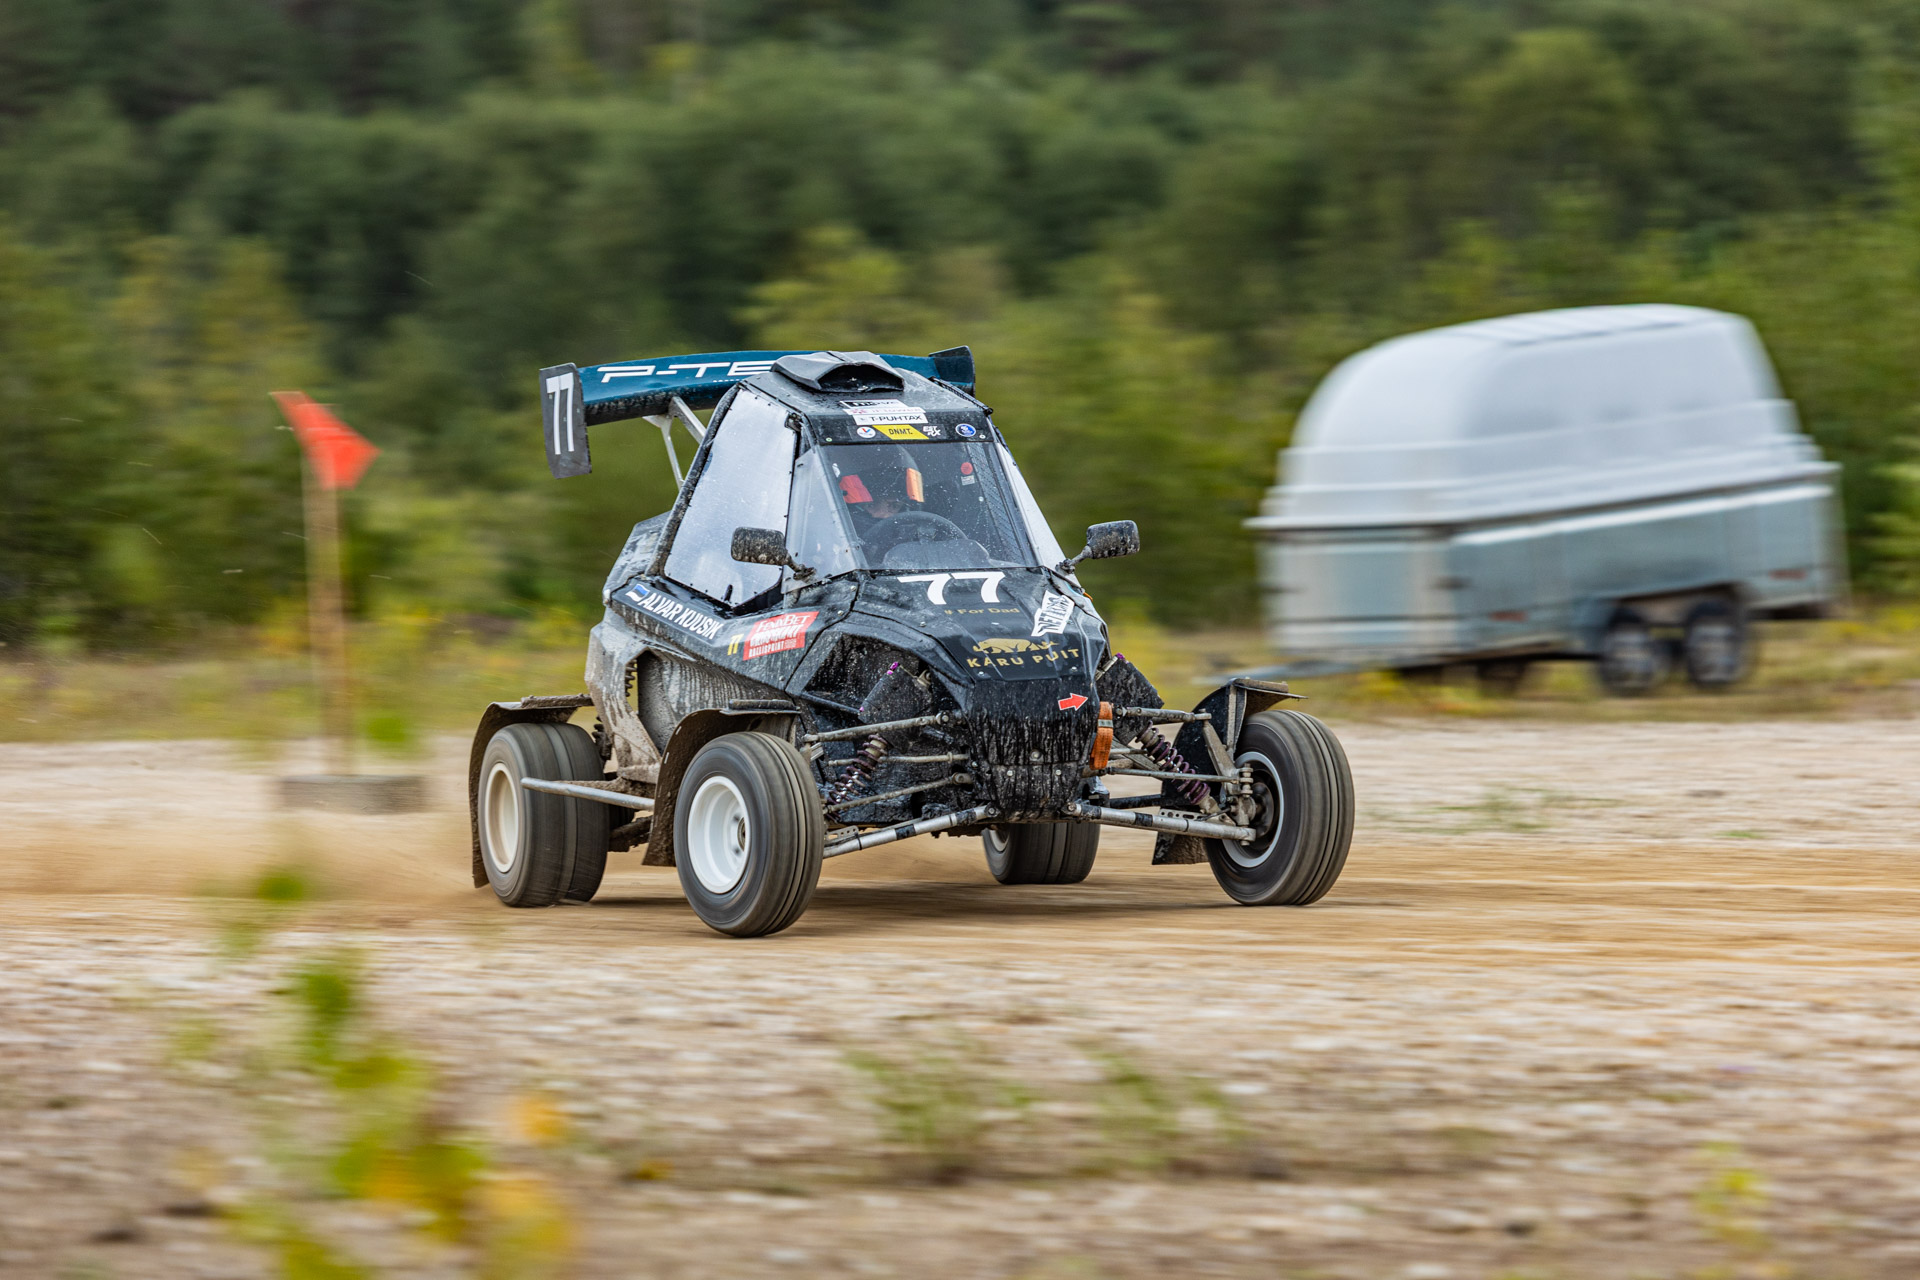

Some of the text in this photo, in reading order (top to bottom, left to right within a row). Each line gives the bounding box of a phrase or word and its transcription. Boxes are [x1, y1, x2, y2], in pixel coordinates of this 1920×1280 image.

[546, 372, 574, 455] 77
[897, 571, 1006, 605] 77
[637, 592, 683, 621] ALVAR
[674, 607, 724, 640] KUUSIK
[966, 648, 1080, 668] KARU PUIT
